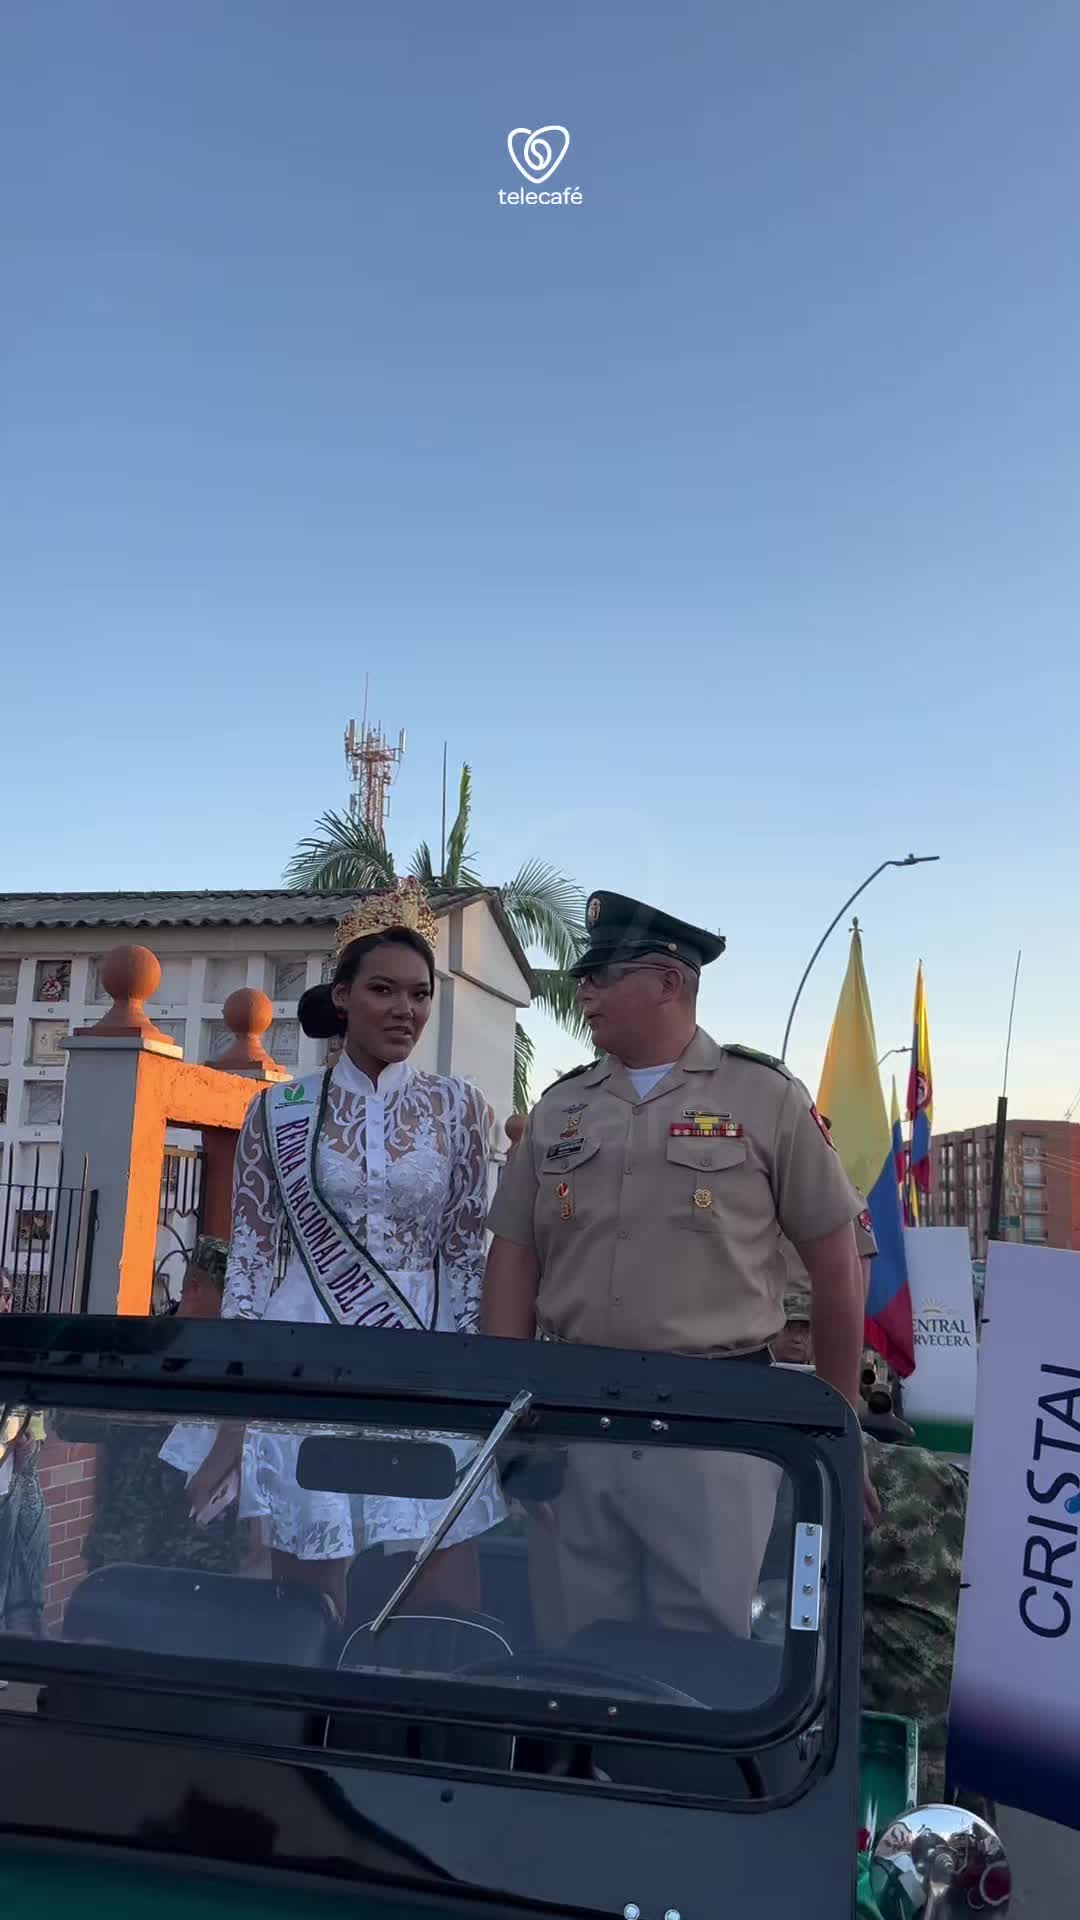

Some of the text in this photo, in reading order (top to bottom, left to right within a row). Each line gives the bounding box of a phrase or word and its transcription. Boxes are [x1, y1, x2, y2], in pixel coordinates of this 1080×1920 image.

[276, 1116, 310, 1178] REINA
[286, 1175, 347, 1275] NACIONAL
[327, 1263, 375, 1314] DEL
[912, 1319, 971, 1334] ENTRAL
[914, 1334, 971, 1347] RVECERA
